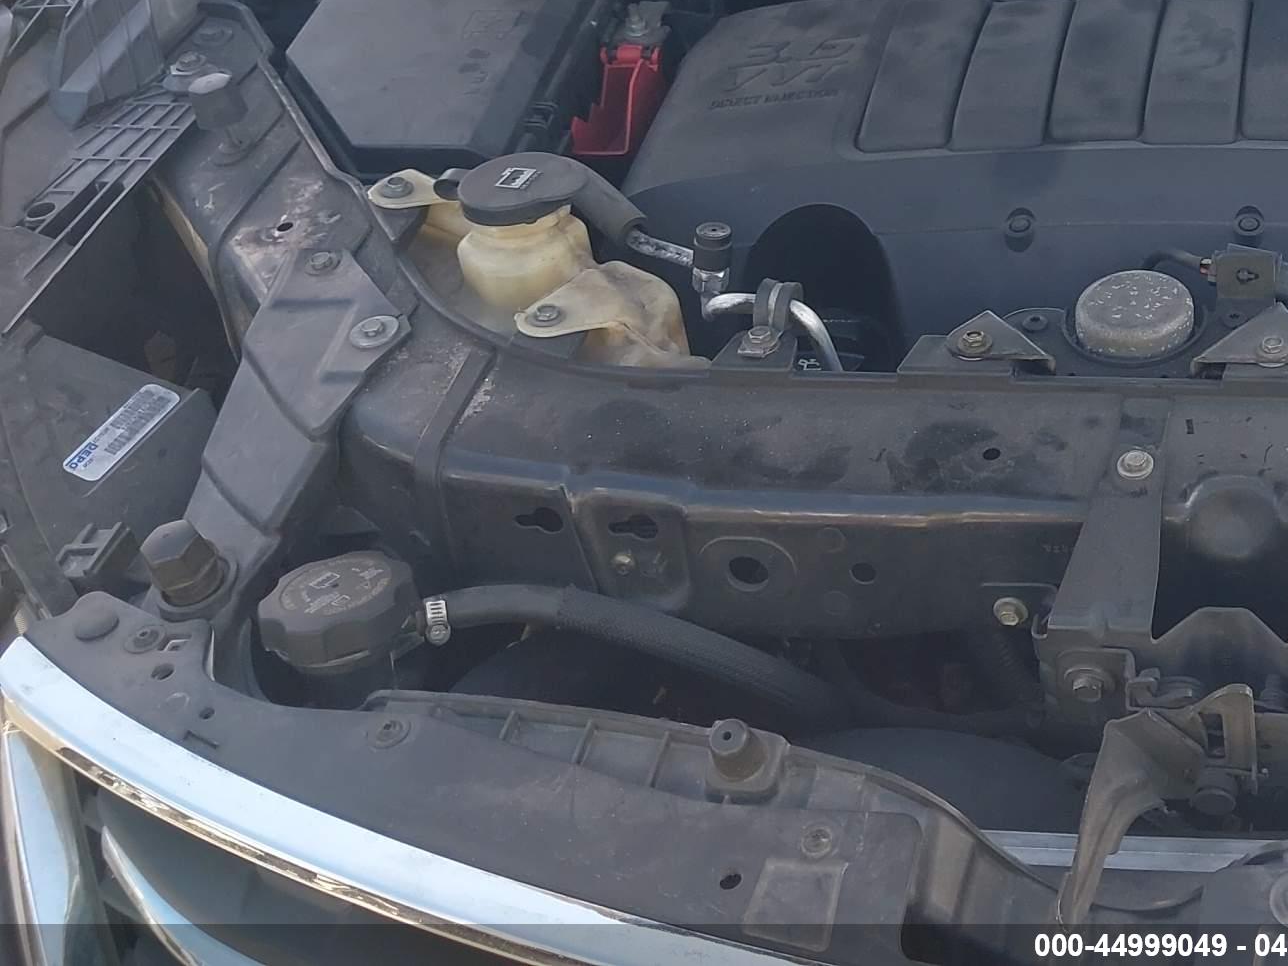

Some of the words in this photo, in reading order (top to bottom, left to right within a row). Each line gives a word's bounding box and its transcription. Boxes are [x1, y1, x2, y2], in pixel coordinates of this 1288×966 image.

[710, 94, 763, 110] DIRECT
[764, 89, 840, 105] INJECTION
[67, 442, 98, 470] DEPO
